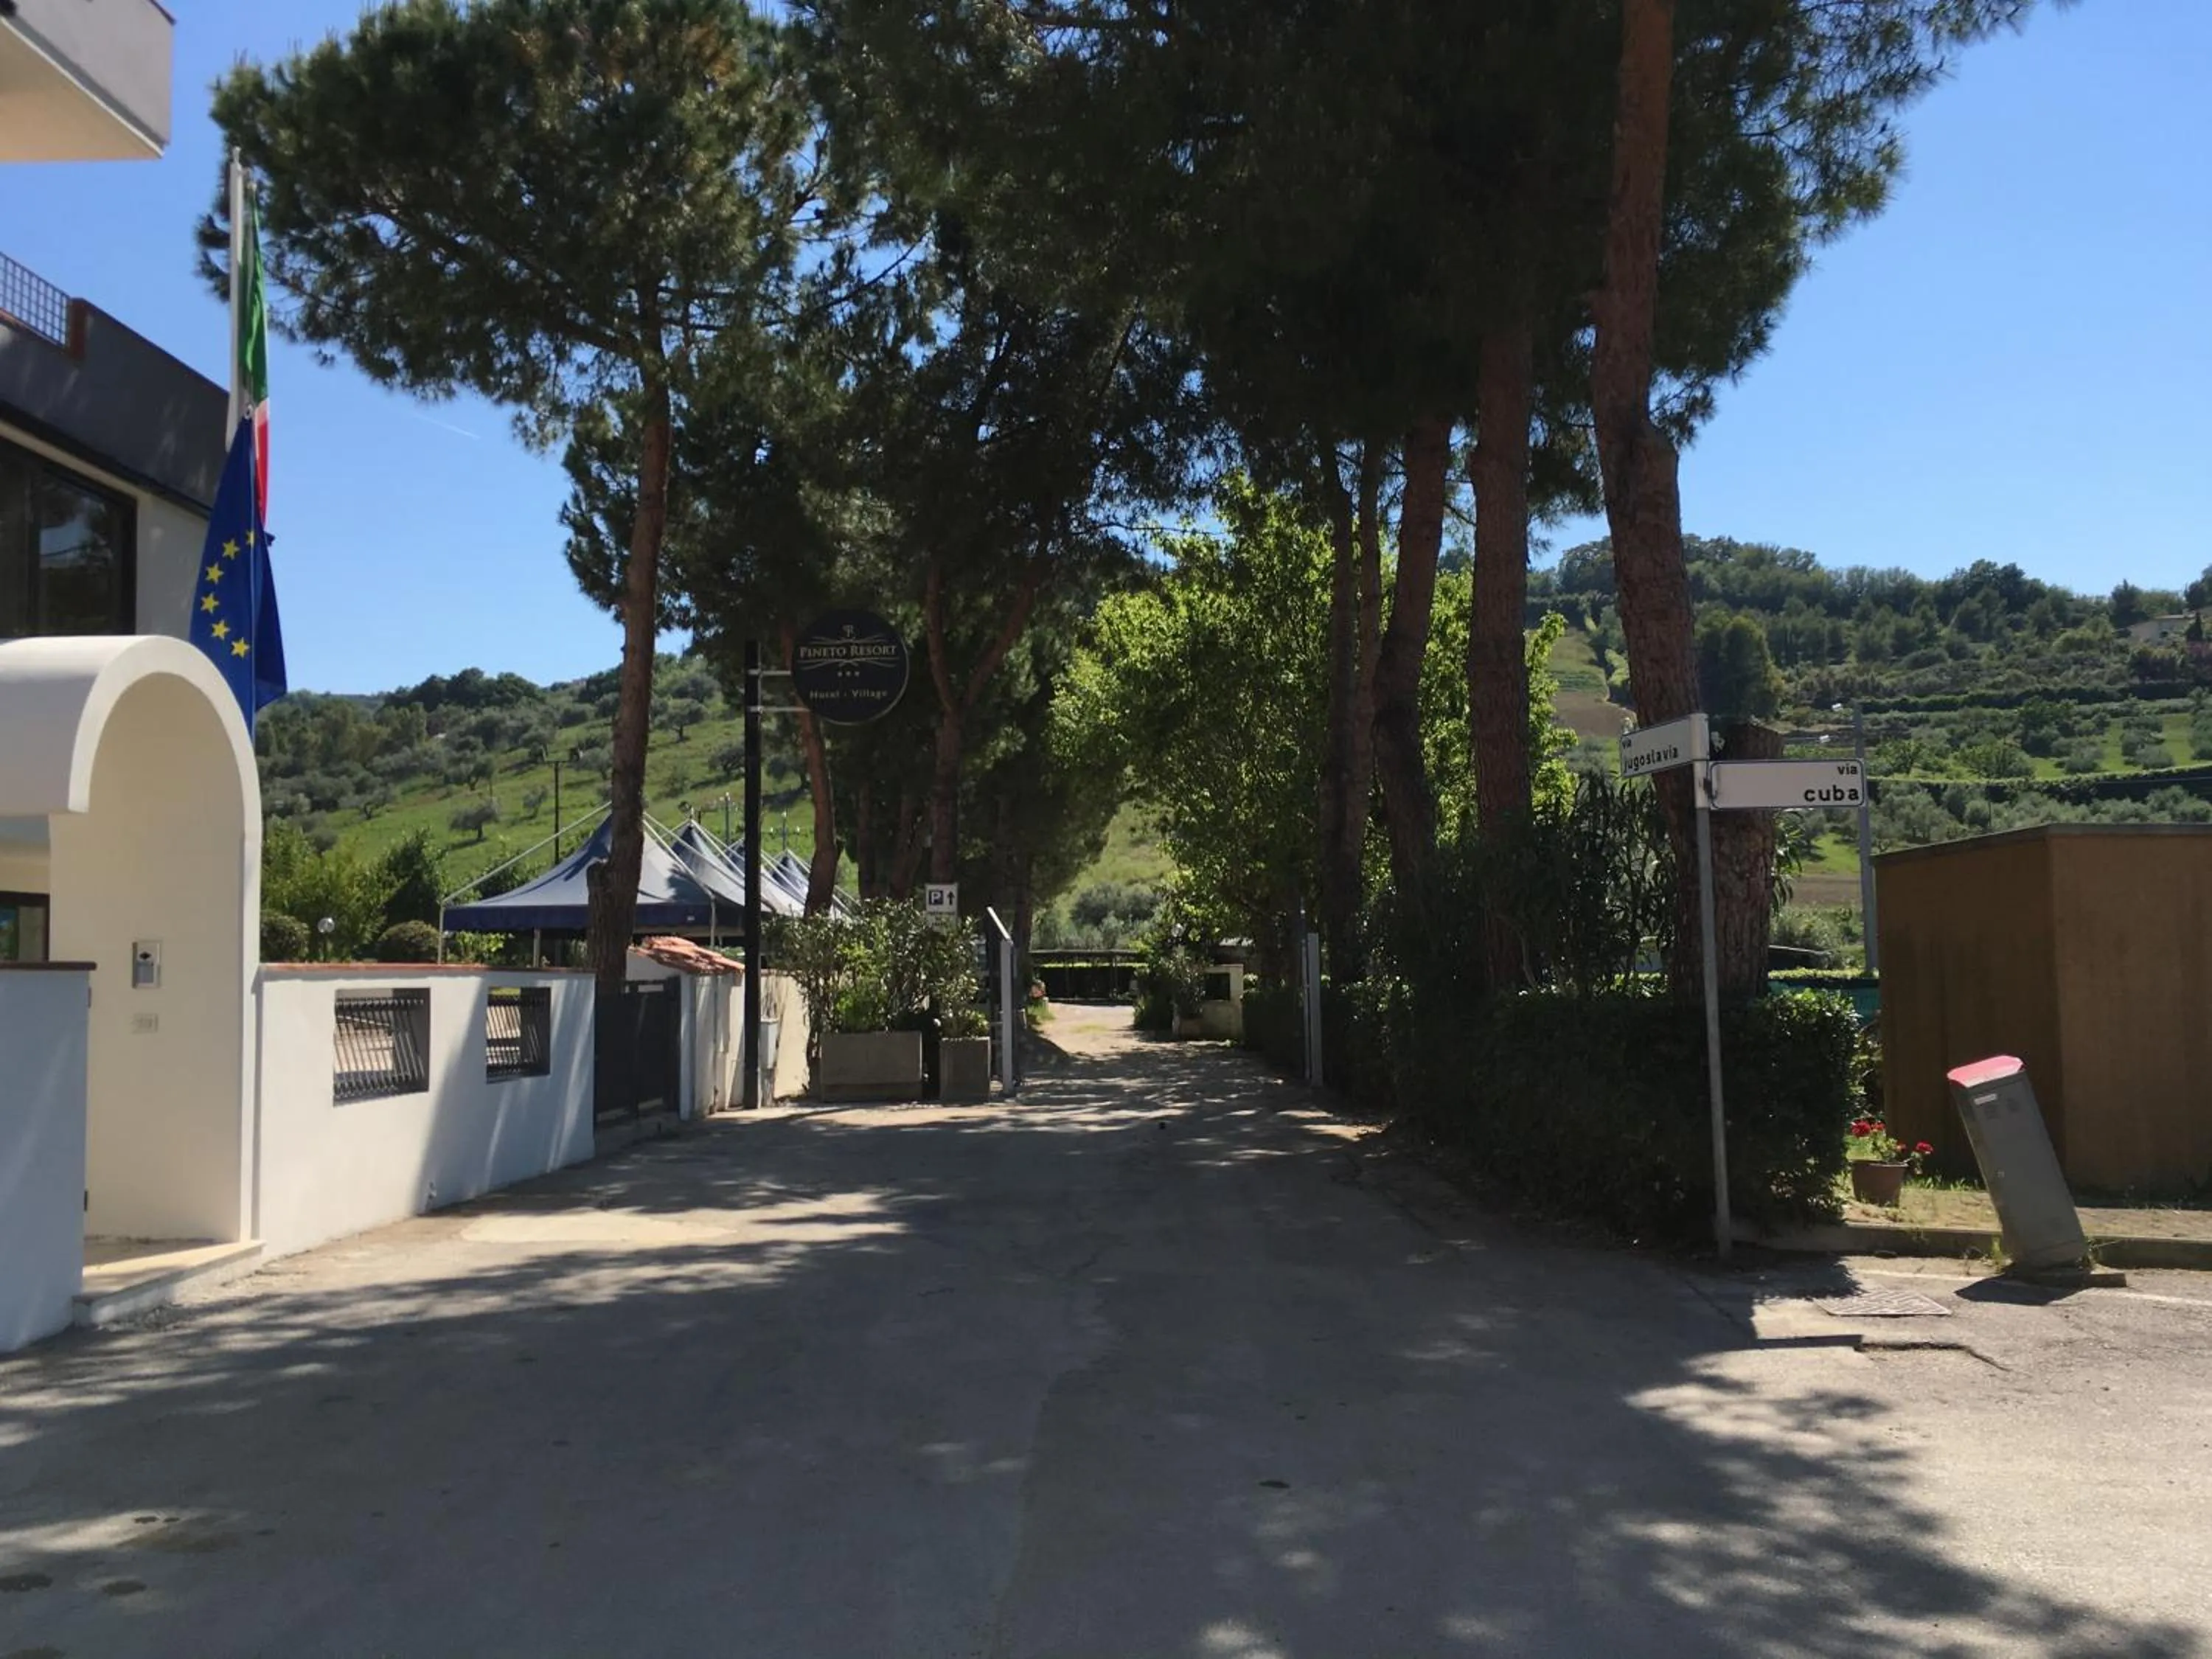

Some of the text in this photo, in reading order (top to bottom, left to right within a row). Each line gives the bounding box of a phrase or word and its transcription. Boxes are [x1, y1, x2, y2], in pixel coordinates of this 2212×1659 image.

[850, 644, 897, 657] RESORT
[1623, 744, 1678, 773] jugoslavia
[1837, 763, 1857, 775] via
[1804, 784, 1859, 802] cuba
[931, 891, 942, 903] P
